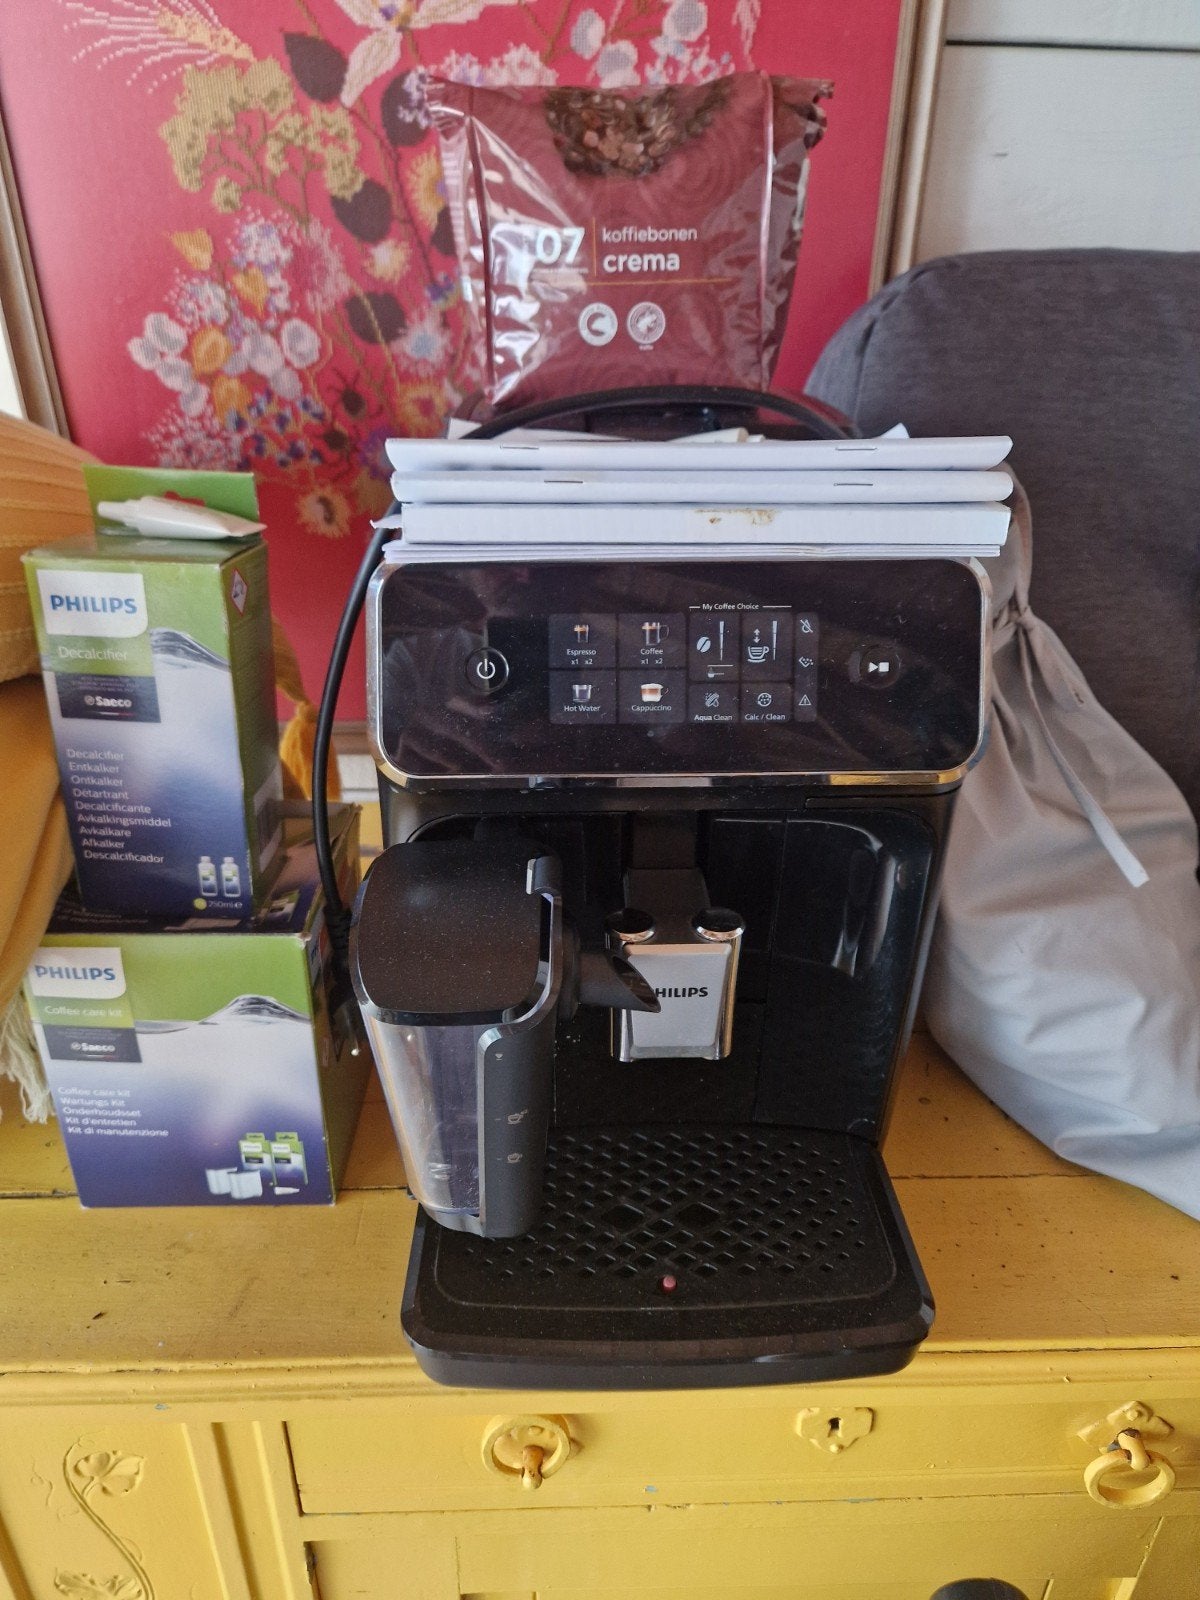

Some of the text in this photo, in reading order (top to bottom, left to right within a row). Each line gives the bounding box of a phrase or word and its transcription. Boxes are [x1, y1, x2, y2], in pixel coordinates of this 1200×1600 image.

[602, 226, 698, 243] koffiebonen
[536, 226, 585, 264] 07
[602, 252, 680, 274] crema
[50, 595, 138, 615] PHILIPS
[702, 603, 712, 611] My
[566, 648, 597, 656] Espresso
[640, 647, 664, 655] Coffee
[95, 695, 132, 708] Saeco
[631, 705, 672, 713] Cappuccino
[66, 749, 124, 761] Decalcifier
[69, 761, 119, 774] Entkalker
[70, 775, 123, 787] Ontkalker
[75, 801, 151, 815] Decalcificante
[77, 814, 172, 828] Avkalkingsmiddel
[79, 826, 132, 837] Avkalkare
[82, 839, 125, 849] Afkalker
[84, 850, 164, 864] Descalcificador
[34, 964, 116, 981] PHILIPS
[654, 987, 709, 998] HILIPS
[45, 1005, 122, 1017] Coffee care kit
[81, 1042, 116, 1053] Saeco
[58, 1086, 130, 1097] Coffee care kit
[65, 1116, 79, 1124] Kit
[67, 1126, 81, 1134] Kit
